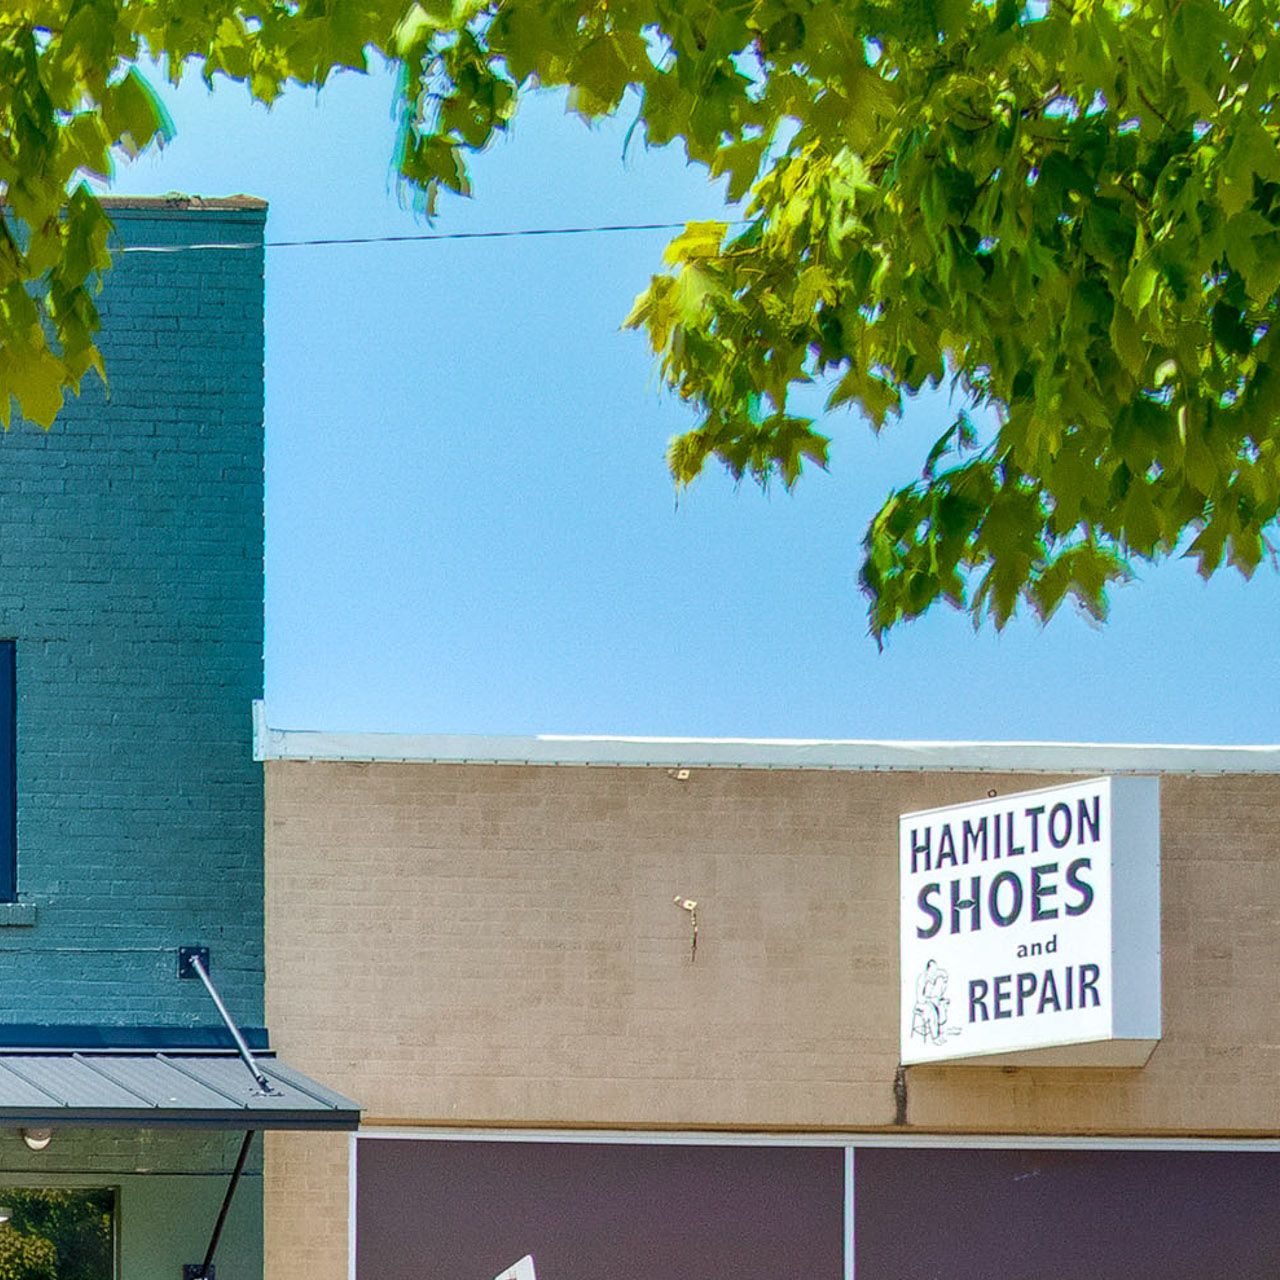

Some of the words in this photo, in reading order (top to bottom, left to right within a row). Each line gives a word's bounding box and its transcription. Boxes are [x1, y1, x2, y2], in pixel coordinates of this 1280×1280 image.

[910, 795, 1101, 874] HAMILTON
[916, 857, 1095, 940] SHOES
[1016, 934, 1058, 959] and
[968, 963, 1101, 1024] REPAIR
